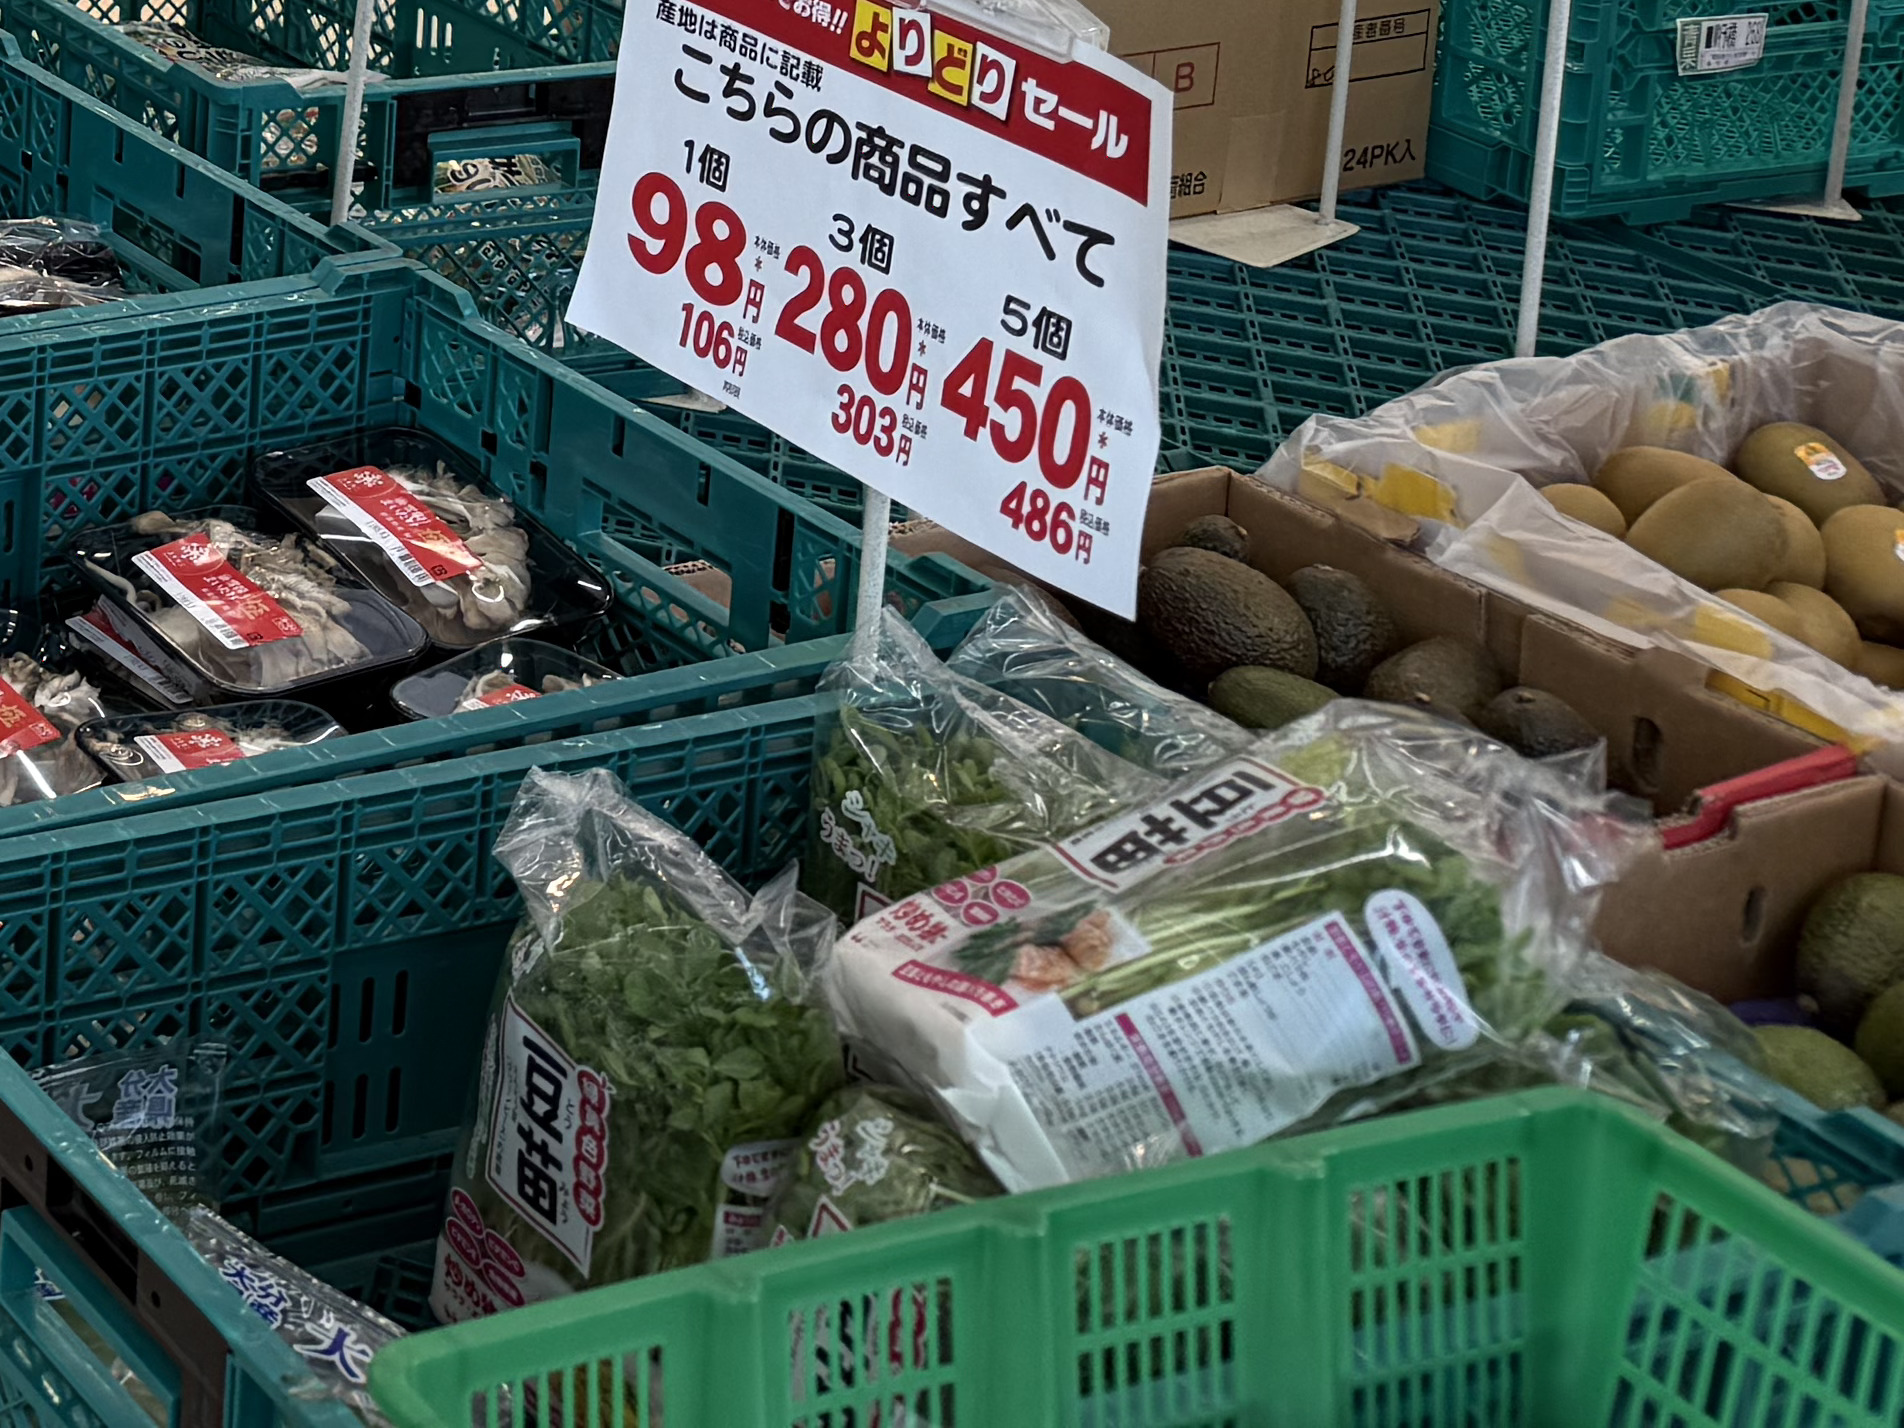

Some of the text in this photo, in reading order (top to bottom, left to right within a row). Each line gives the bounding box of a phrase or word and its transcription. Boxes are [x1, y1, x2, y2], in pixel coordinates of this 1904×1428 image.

[674, 43, 1116, 289] こちらの商品すべて
[1175, 61, 1196, 94] B
[683, 139, 1073, 361] 1個 3個 5個
